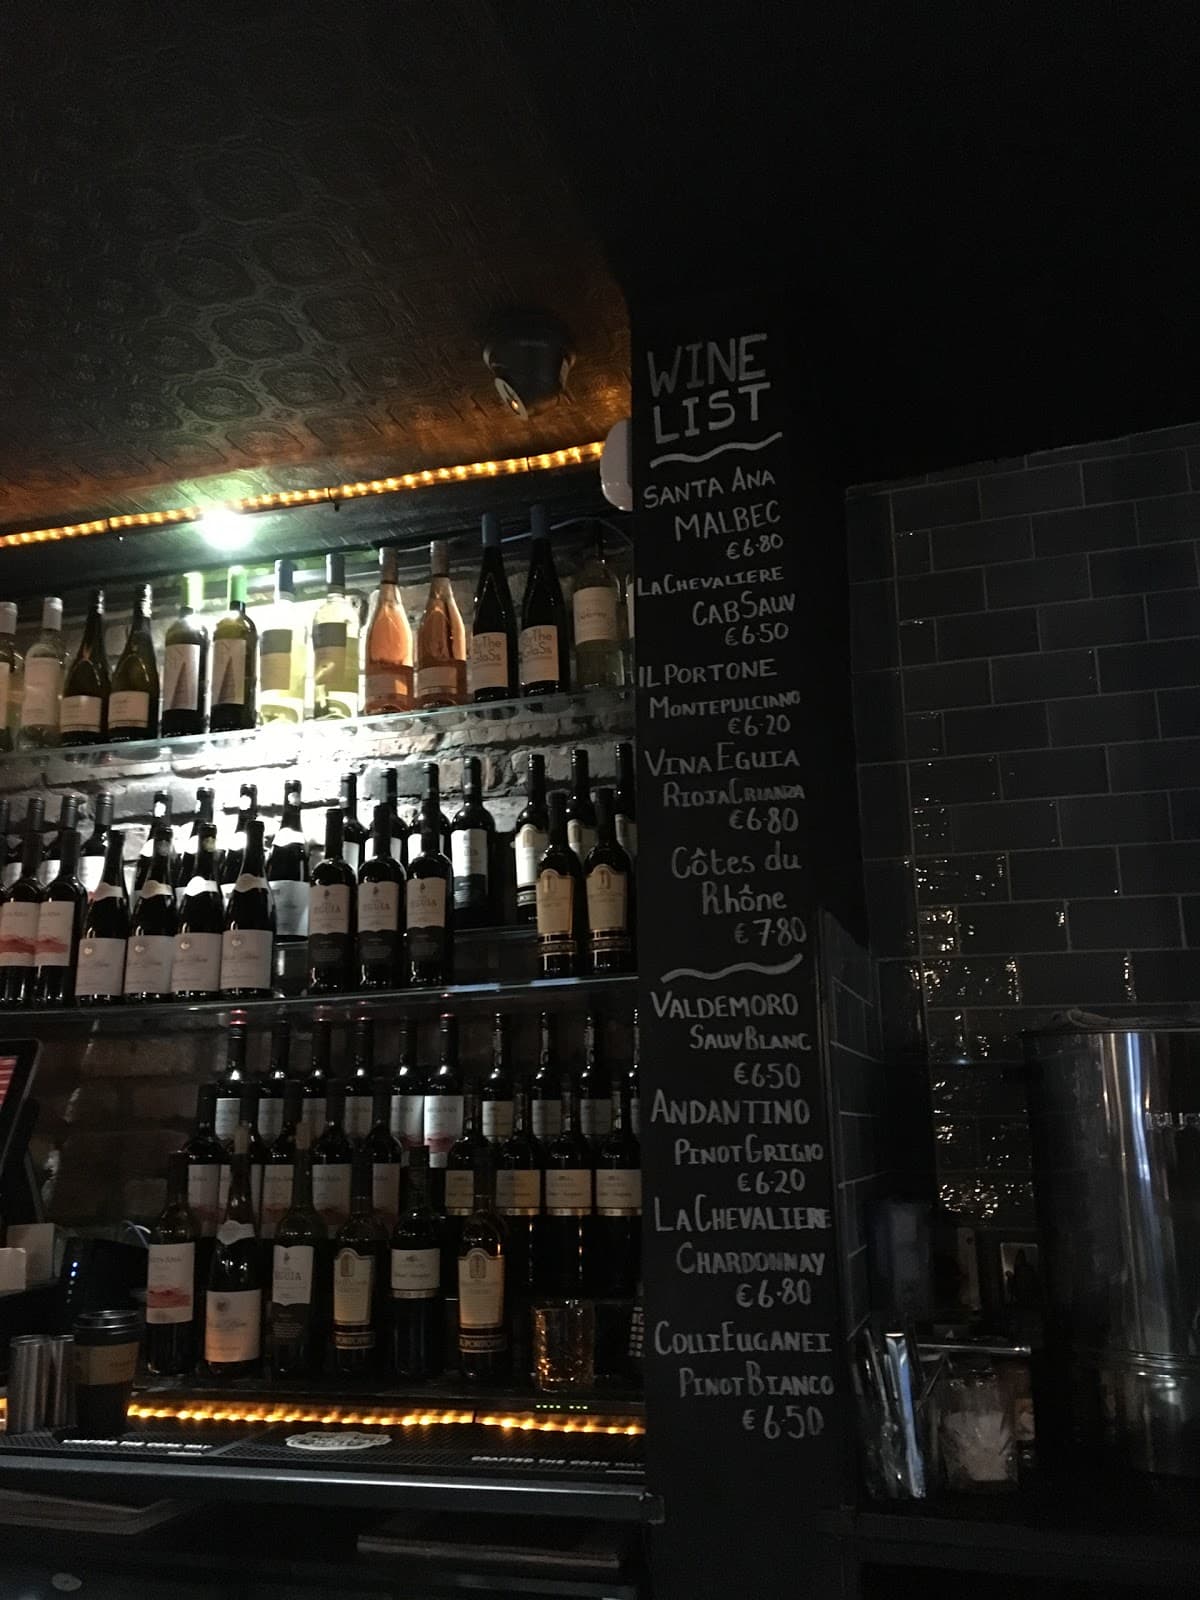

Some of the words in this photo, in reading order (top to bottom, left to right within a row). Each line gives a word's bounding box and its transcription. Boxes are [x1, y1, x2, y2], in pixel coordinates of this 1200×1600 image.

[647, 332, 768, 398] WINE
[653, 381, 771, 445] LIST
[644, 476, 724, 509] SANTA
[732, 465, 776, 493] ANA
[674, 500, 782, 542] MALBEC
[649, 690, 800, 720] MONTEPULCIANO
[716, 741, 801, 771] EGUIA
[671, 846, 755, 880] Côtes
[764, 841, 802, 872] du
[701, 880, 787, 916] Rhône
[650, 990, 799, 1019] VALDEMORO
[650, 1088, 810, 1125] ANDANTINO
[676, 1241, 826, 1276] CHARDONNAY
